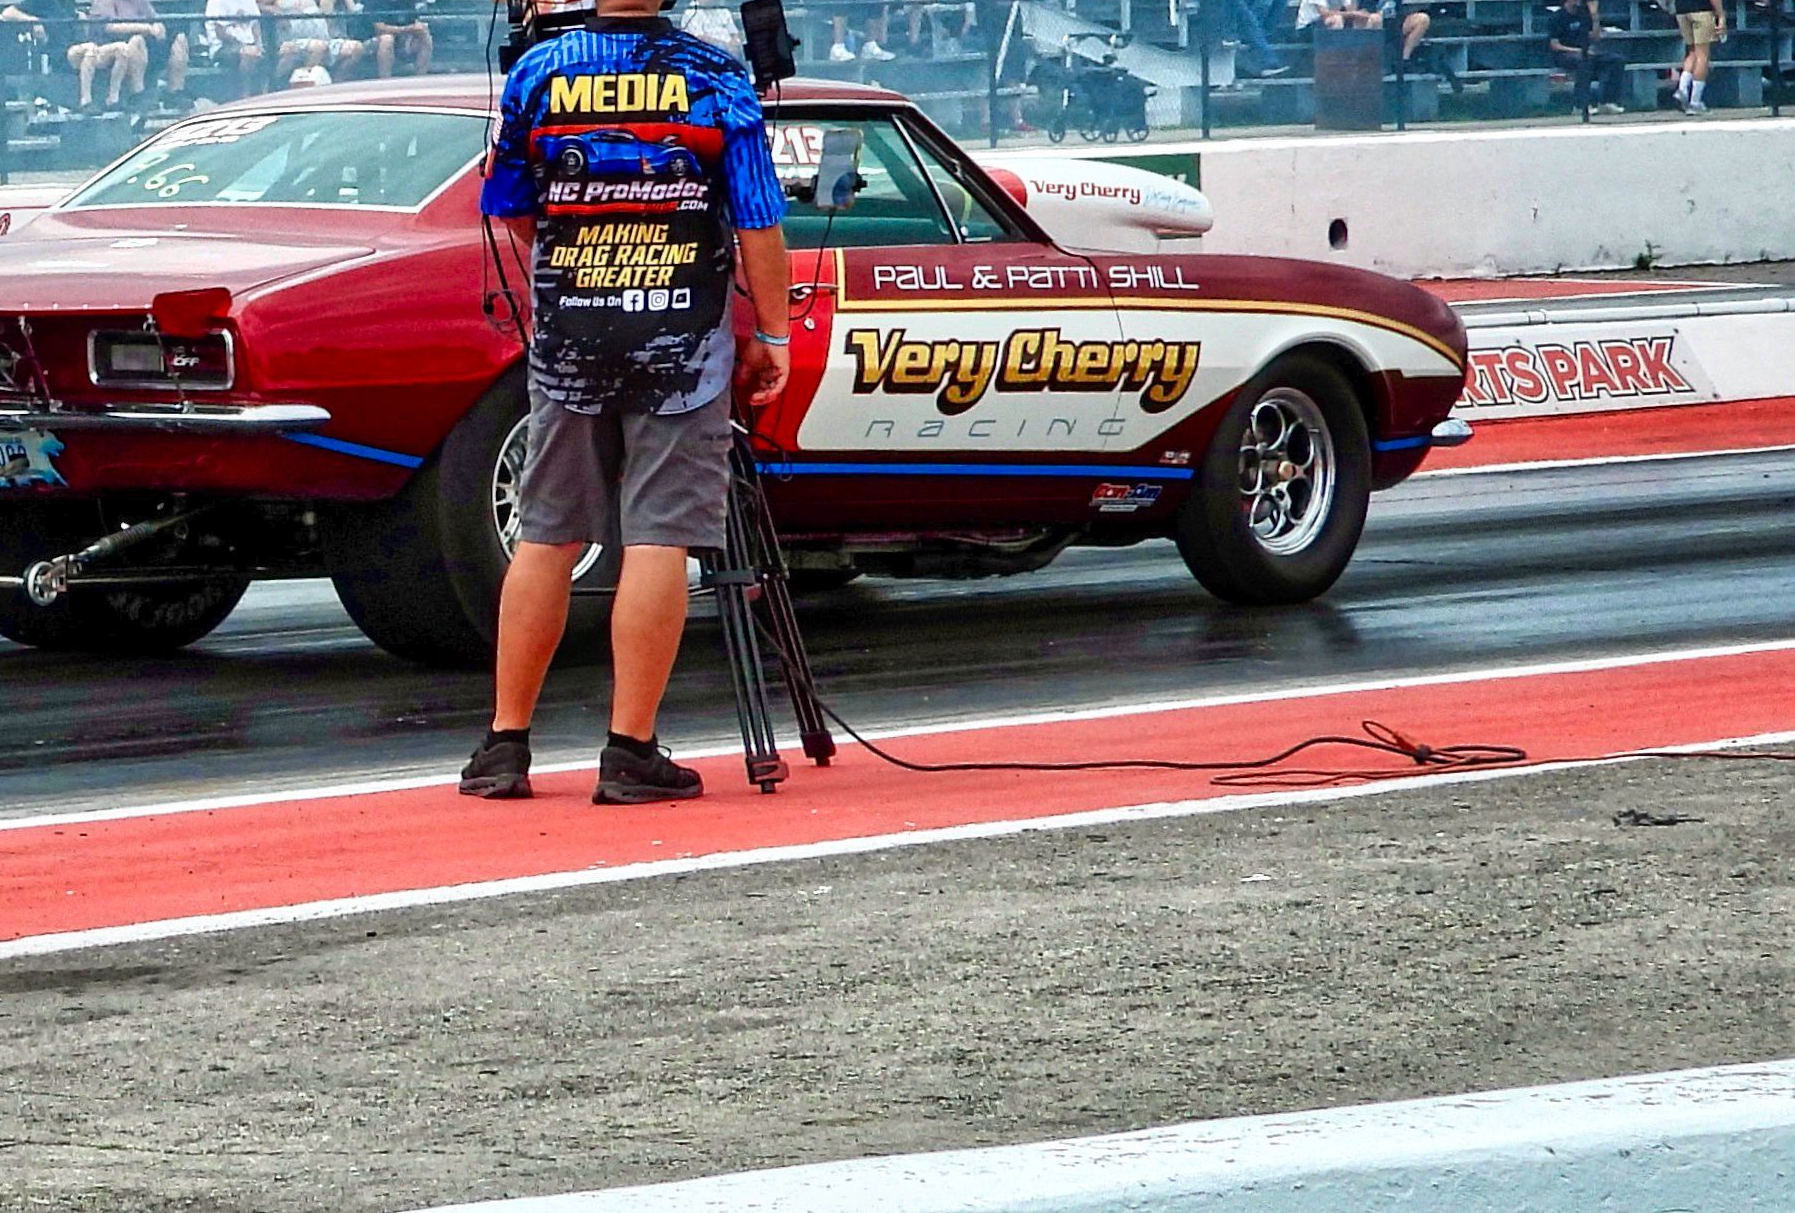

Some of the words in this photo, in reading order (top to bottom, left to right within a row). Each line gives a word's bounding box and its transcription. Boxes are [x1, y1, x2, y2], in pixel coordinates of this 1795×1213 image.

[550, 74, 689, 114] MEDIA
[548, 181, 581, 202] NC
[1030, 180, 1076, 200] Very
[1081, 182, 1141, 205] Cherry
[576, 223, 669, 245] MAKING
[551, 245, 611, 267] DRAG
[613, 242, 698, 266] RACING
[576, 265, 675, 288] GREATER
[972, 265, 1002, 288] &
[1108, 266, 1200, 289] SHILL
[559, 296, 591, 308] Follow
[846, 329, 1000, 414] Very
[996, 328, 1201, 413] Cherry
[1538, 338, 1693, 400] PARK
